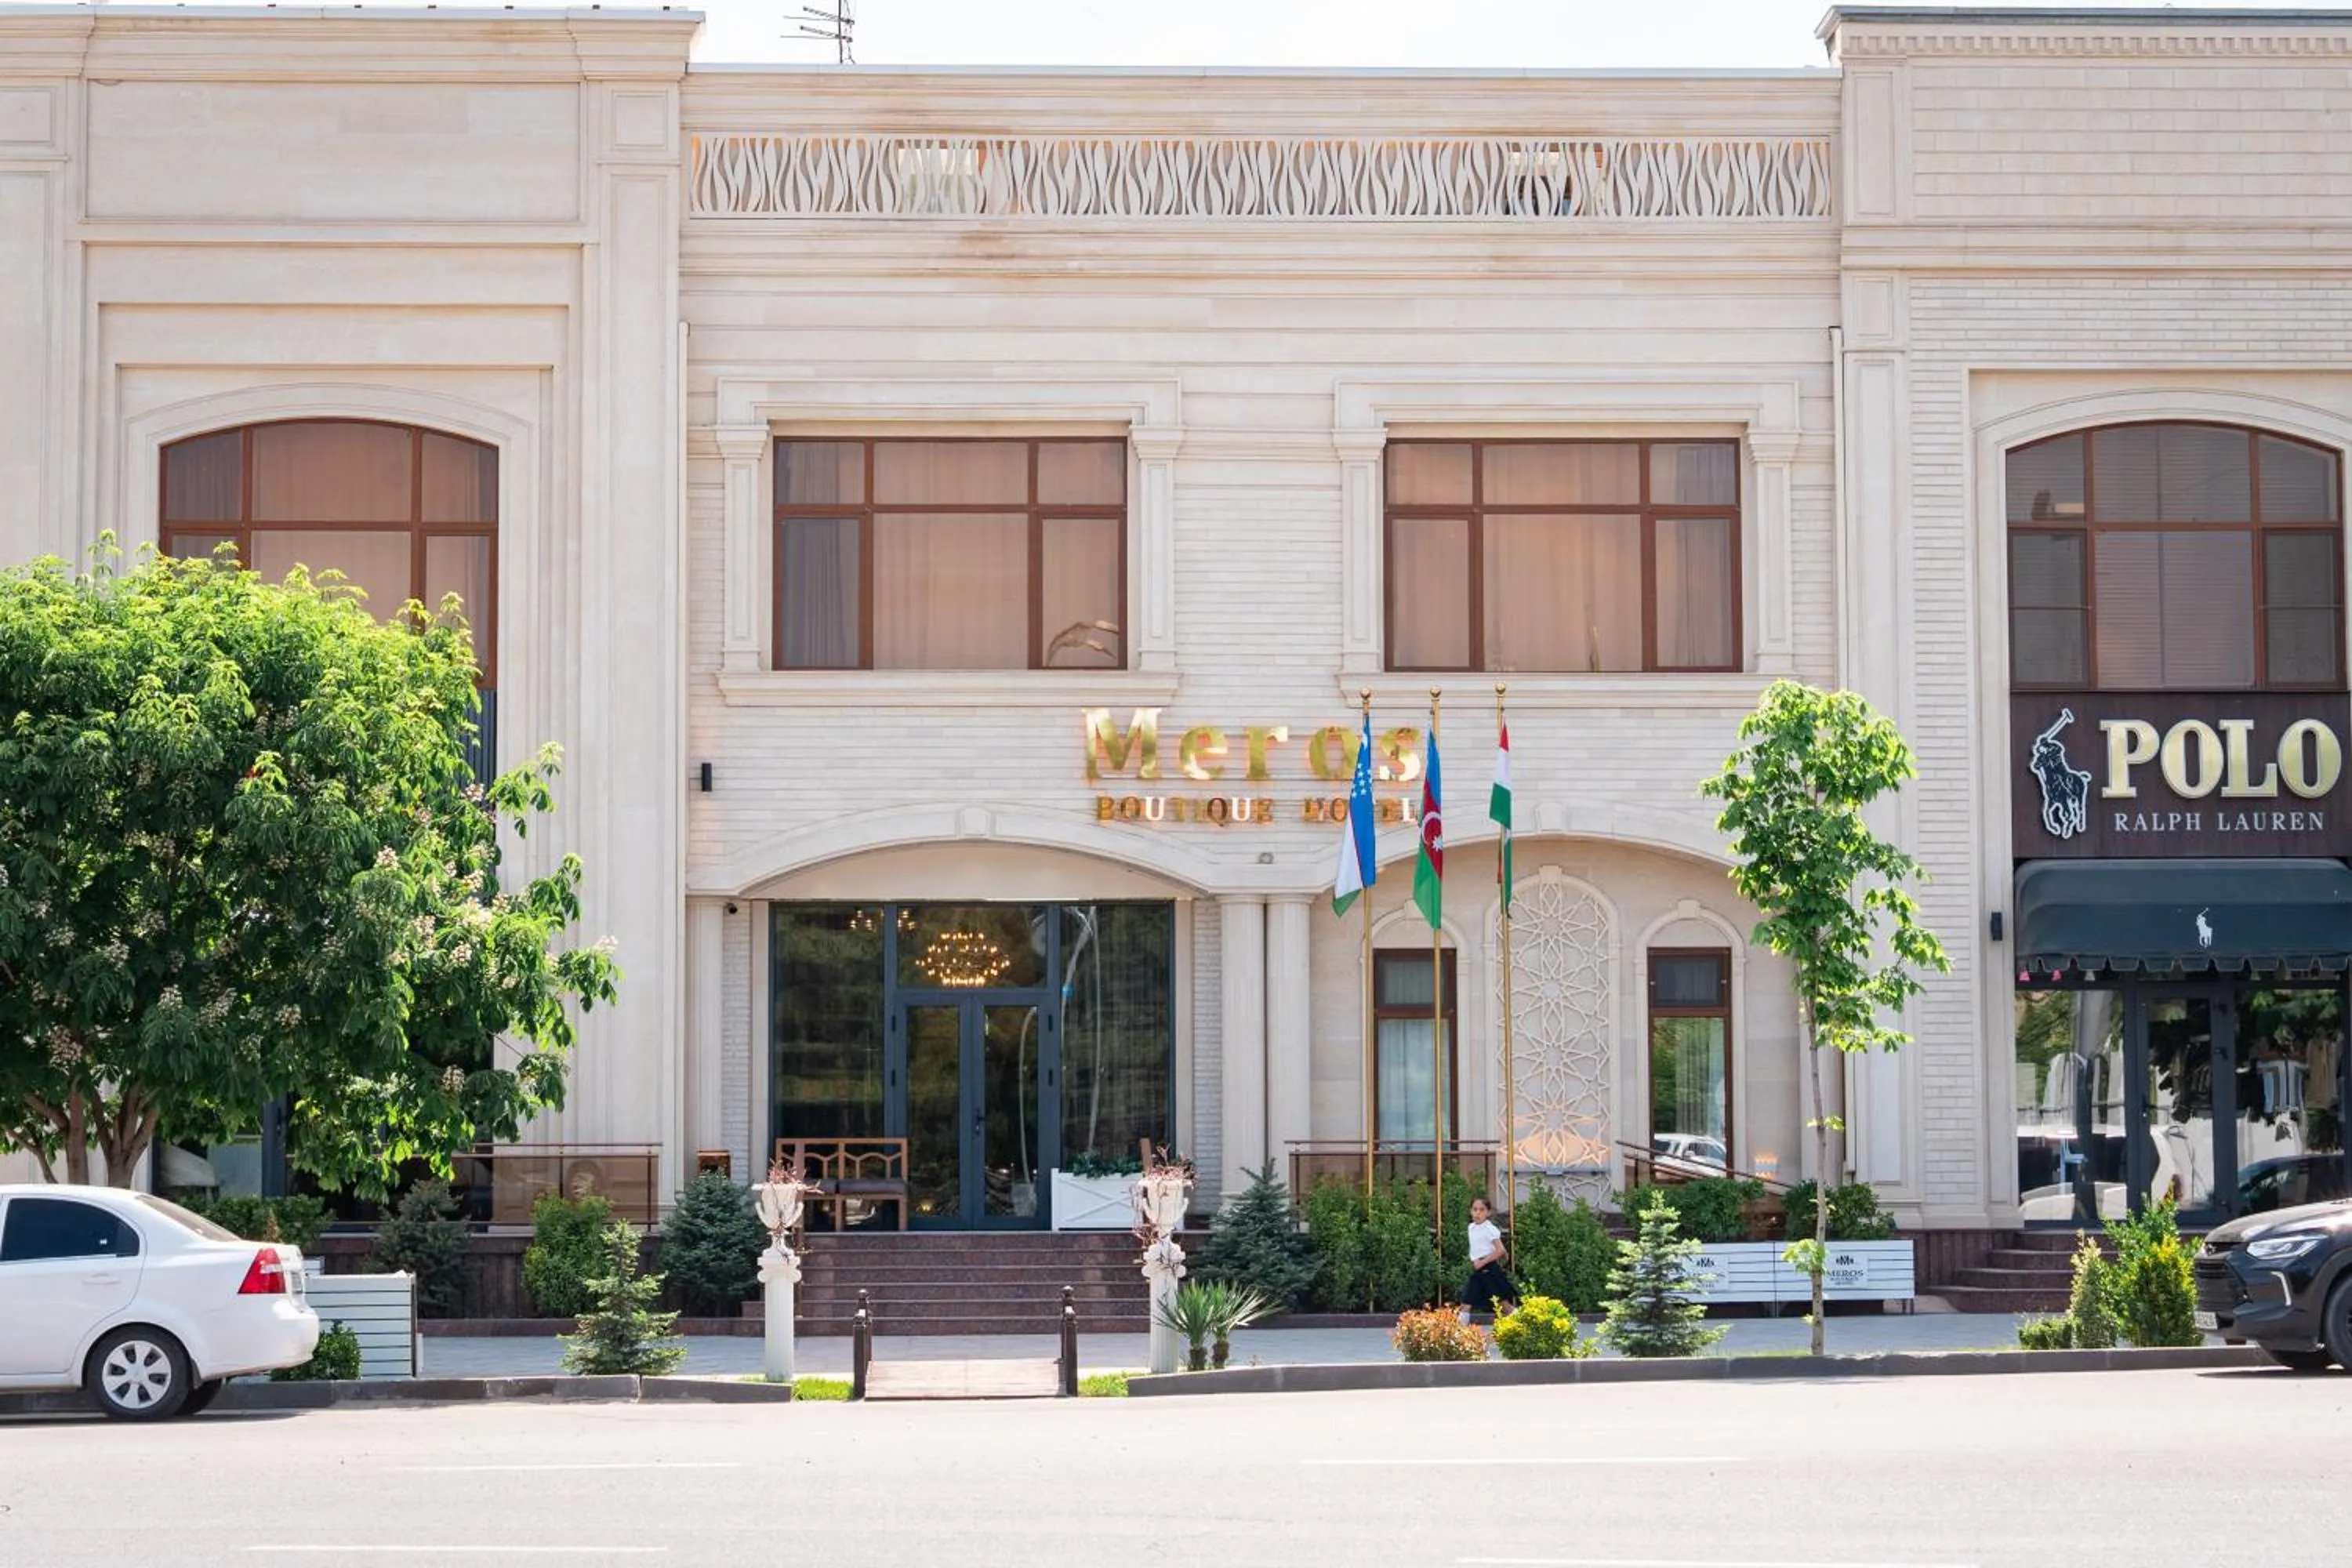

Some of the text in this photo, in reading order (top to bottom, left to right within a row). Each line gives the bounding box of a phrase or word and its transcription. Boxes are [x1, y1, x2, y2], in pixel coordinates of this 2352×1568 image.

[1082, 707, 1421, 781] Meros
[2100, 718, 2342, 799] POLO
[1096, 796, 1417, 826] BOUTIQUE HOEL
[2114, 811, 2325, 832] RALPH LAUREN
